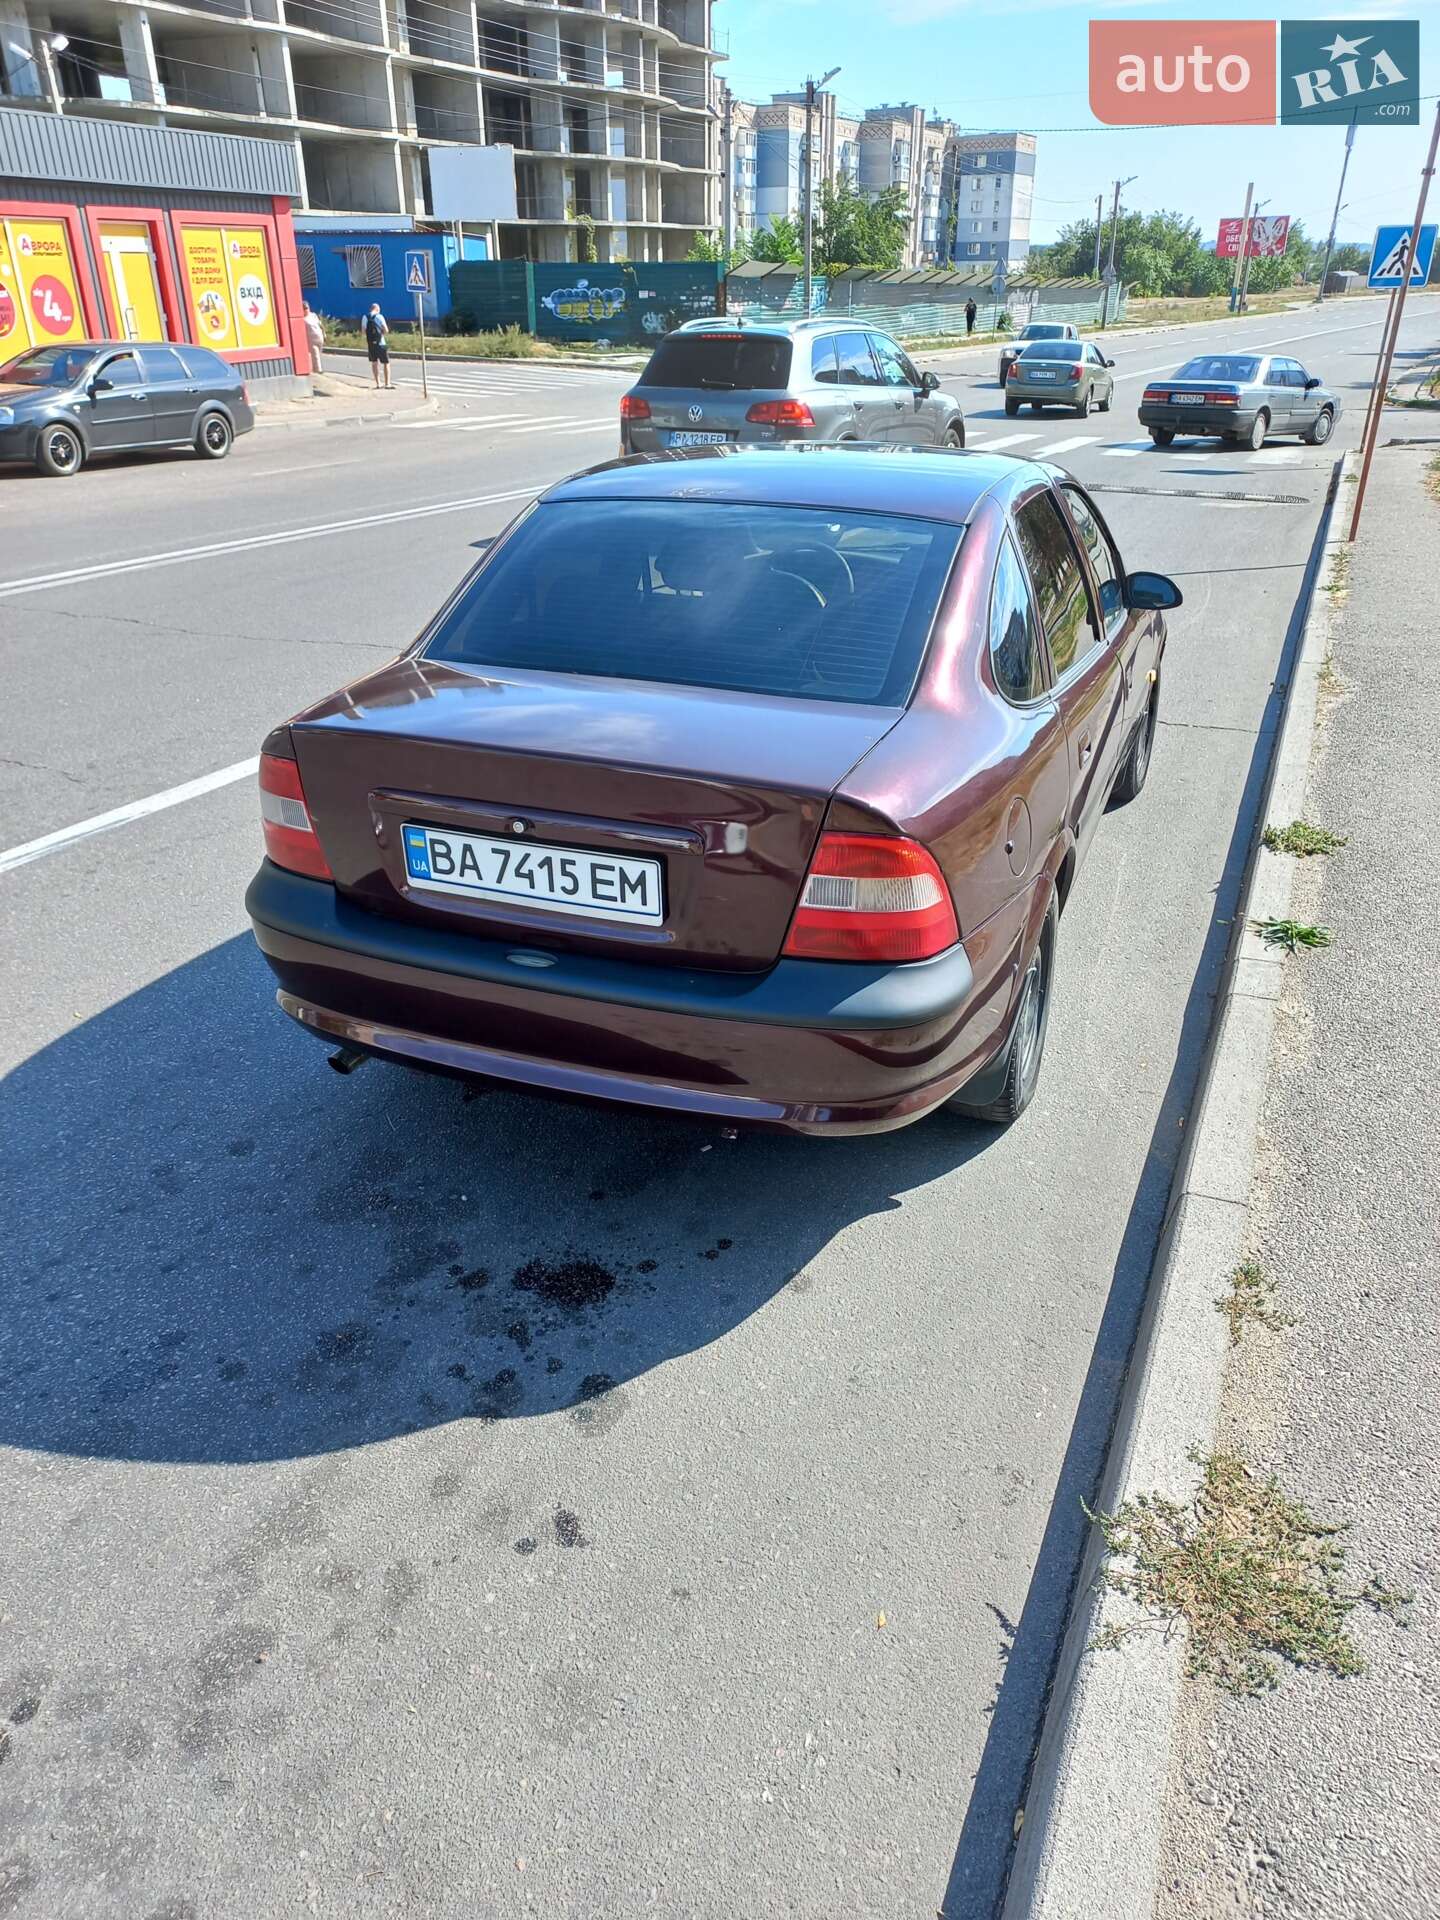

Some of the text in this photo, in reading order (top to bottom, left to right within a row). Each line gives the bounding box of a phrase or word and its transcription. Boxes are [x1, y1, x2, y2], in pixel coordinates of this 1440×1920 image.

[240, 287, 264, 299] ВХІД
[44, 289, 62, 322] 4
[412, 858, 430, 873] UA
[429, 837, 648, 907] BA 7415 EM
